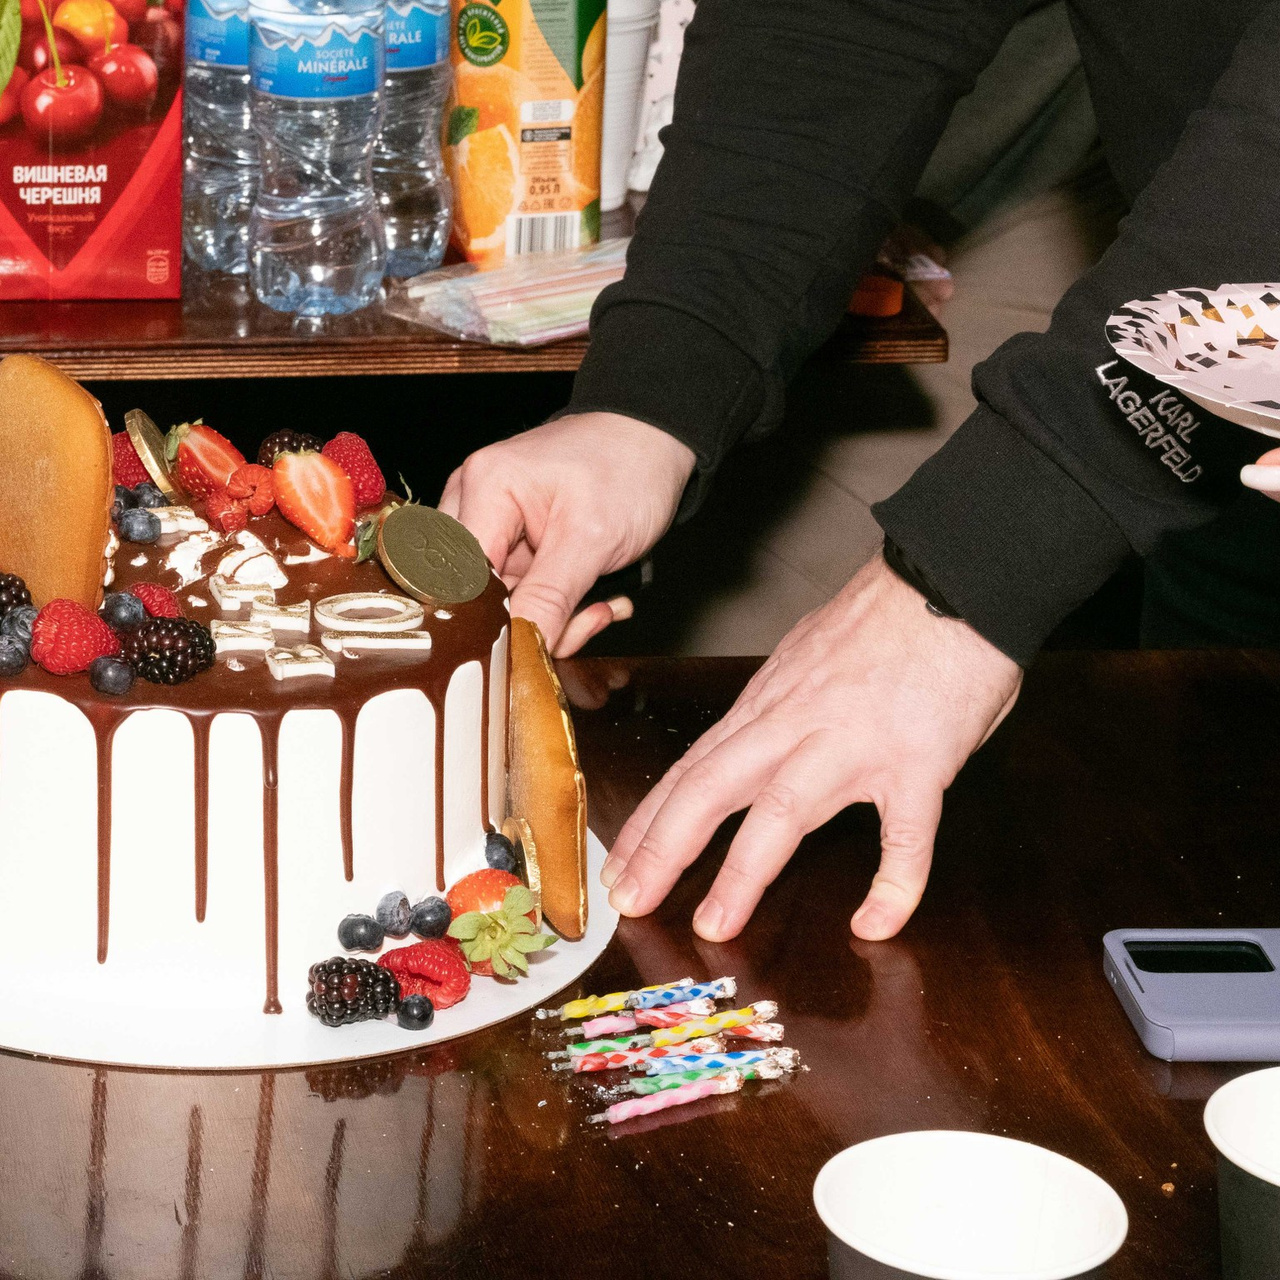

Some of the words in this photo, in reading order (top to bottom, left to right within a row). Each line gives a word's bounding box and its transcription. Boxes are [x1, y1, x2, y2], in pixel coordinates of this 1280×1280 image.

[13, 164, 108, 185] ВИШНЕВАЯ
[19, 187, 101, 205] ЧЕРЕШНЯ
[1095, 359, 1203, 483] LAGERFELD
[1148, 389, 1202, 444] KARL
